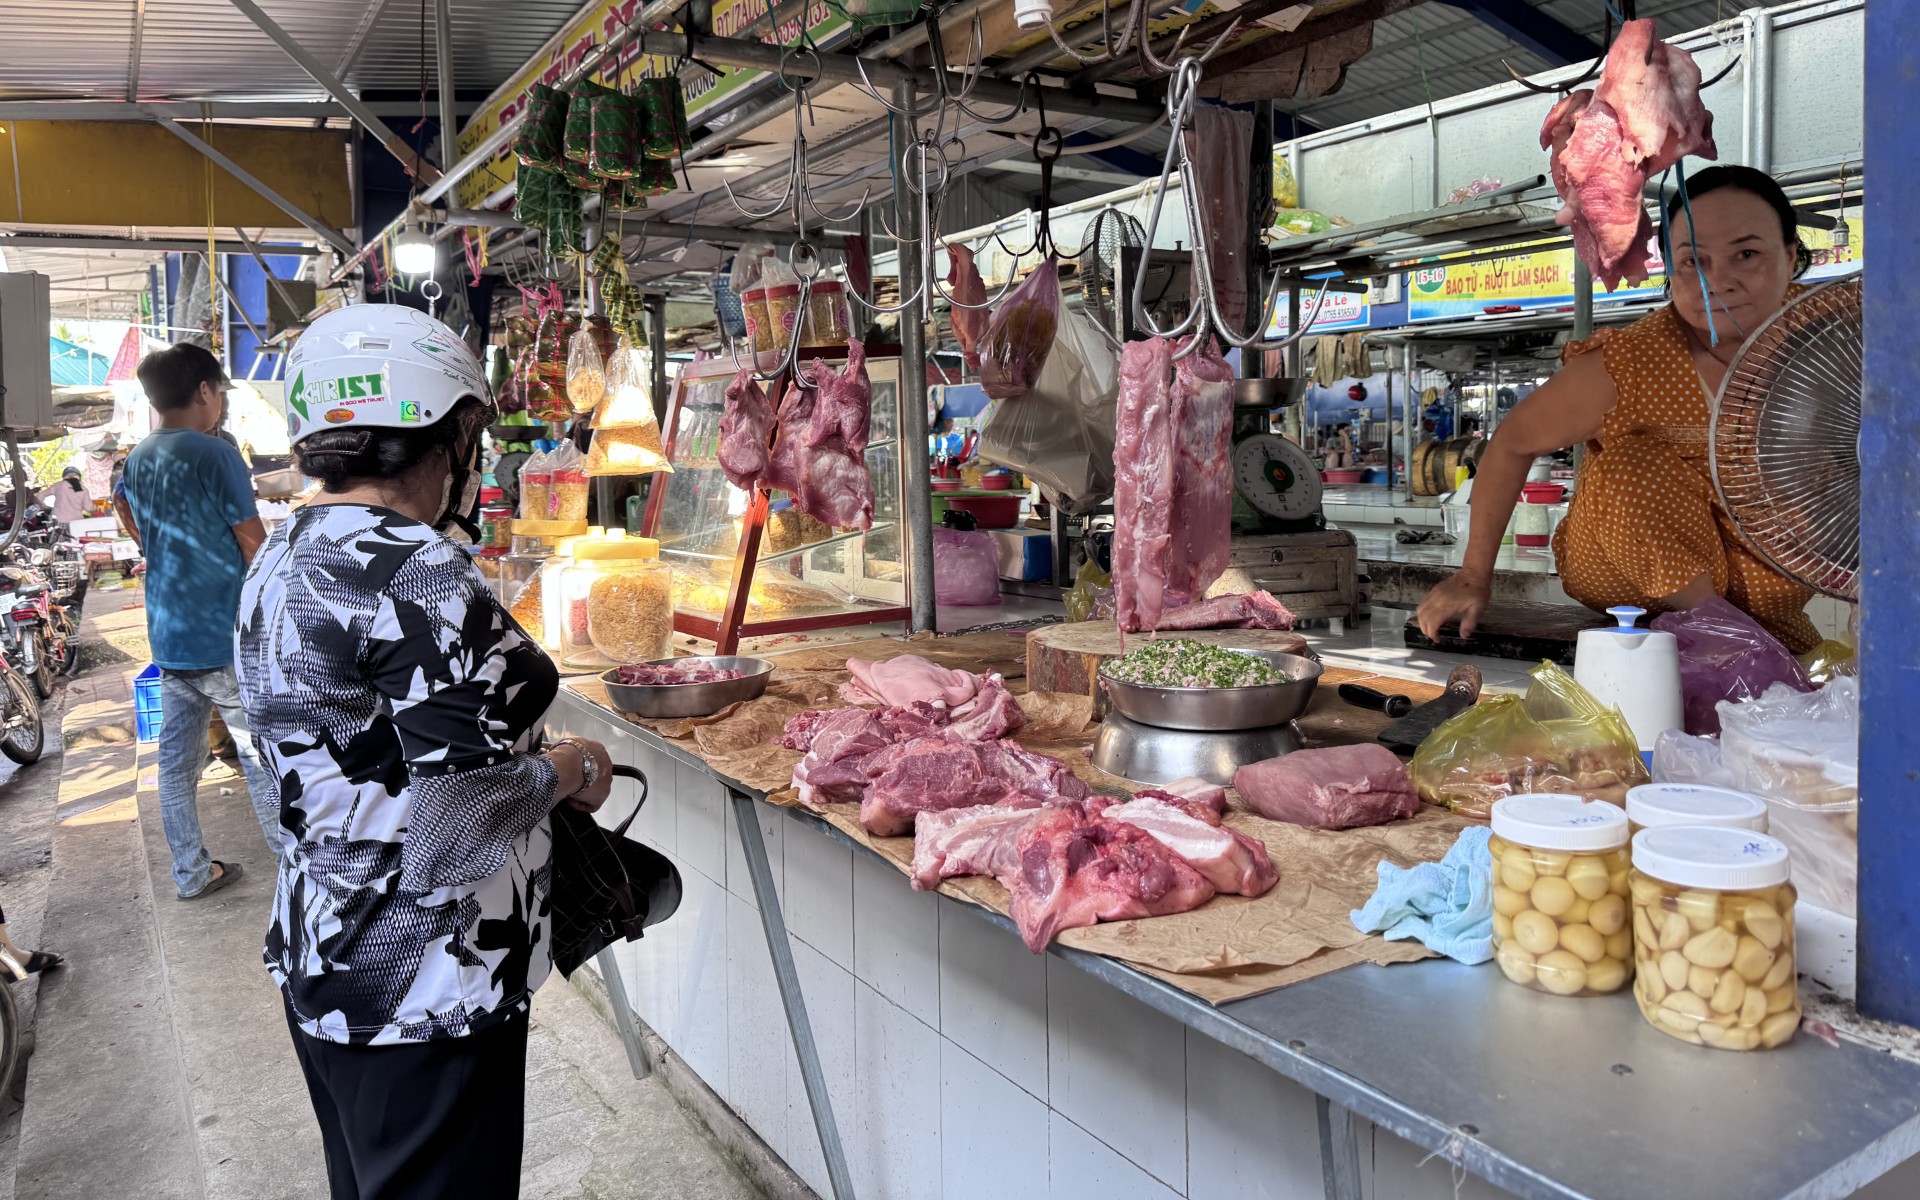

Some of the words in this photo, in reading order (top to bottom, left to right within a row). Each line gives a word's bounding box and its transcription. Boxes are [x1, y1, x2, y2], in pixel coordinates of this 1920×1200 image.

[1416, 269, 1443, 285] 15-16
[1446, 278, 1463, 295] BAO
[1534, 265, 1559, 290] SẠCH
[304, 373, 384, 405] CHRIST
